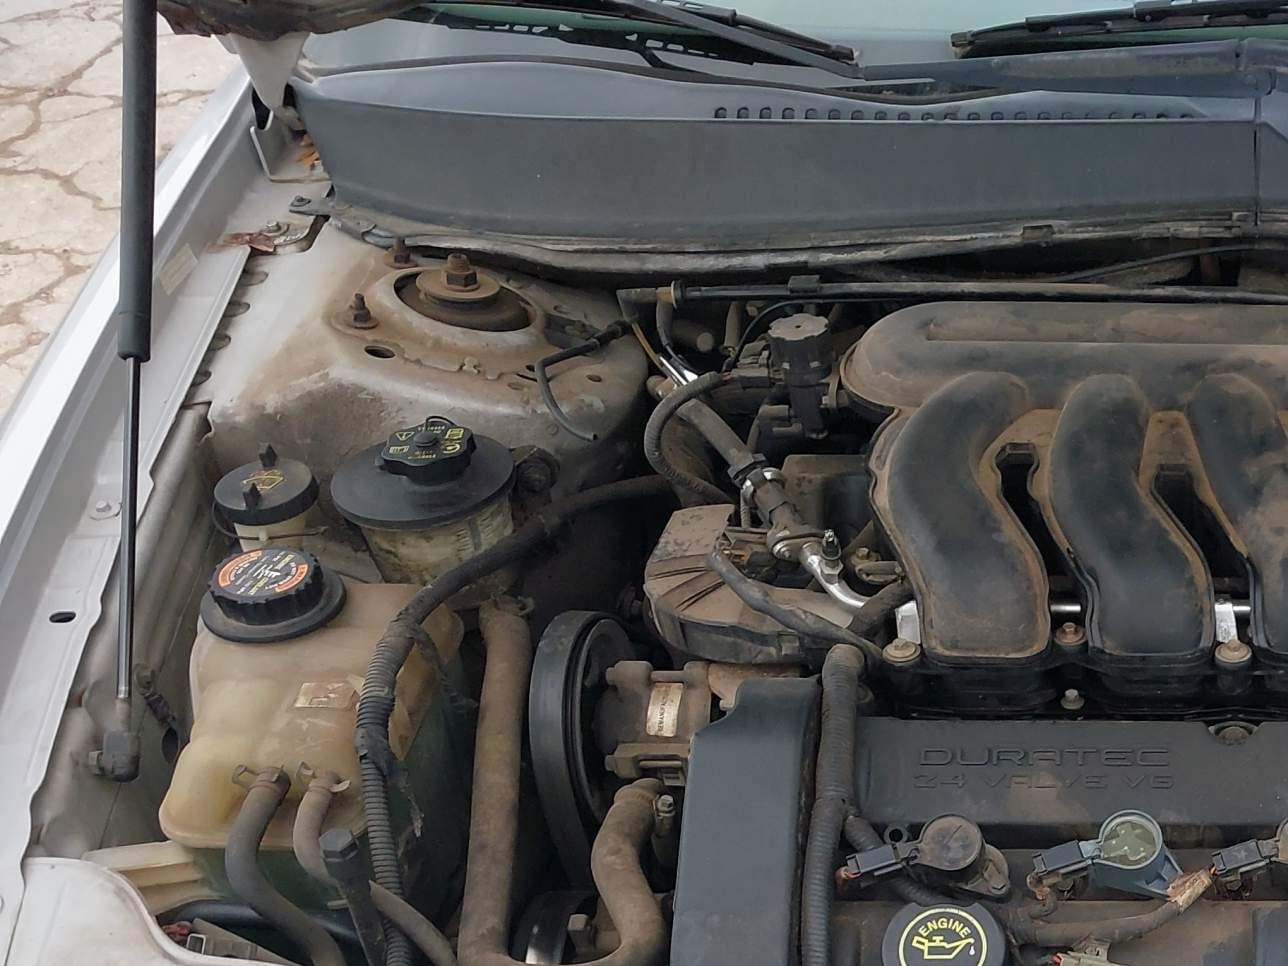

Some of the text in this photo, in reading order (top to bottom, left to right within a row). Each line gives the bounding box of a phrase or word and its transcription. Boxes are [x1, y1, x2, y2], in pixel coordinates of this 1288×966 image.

[919, 749, 1169, 767] DURATEC
[913, 774, 968, 789] 24
[984, 774, 1108, 789] VALVE
[918, 918, 972, 938] ENGINE
